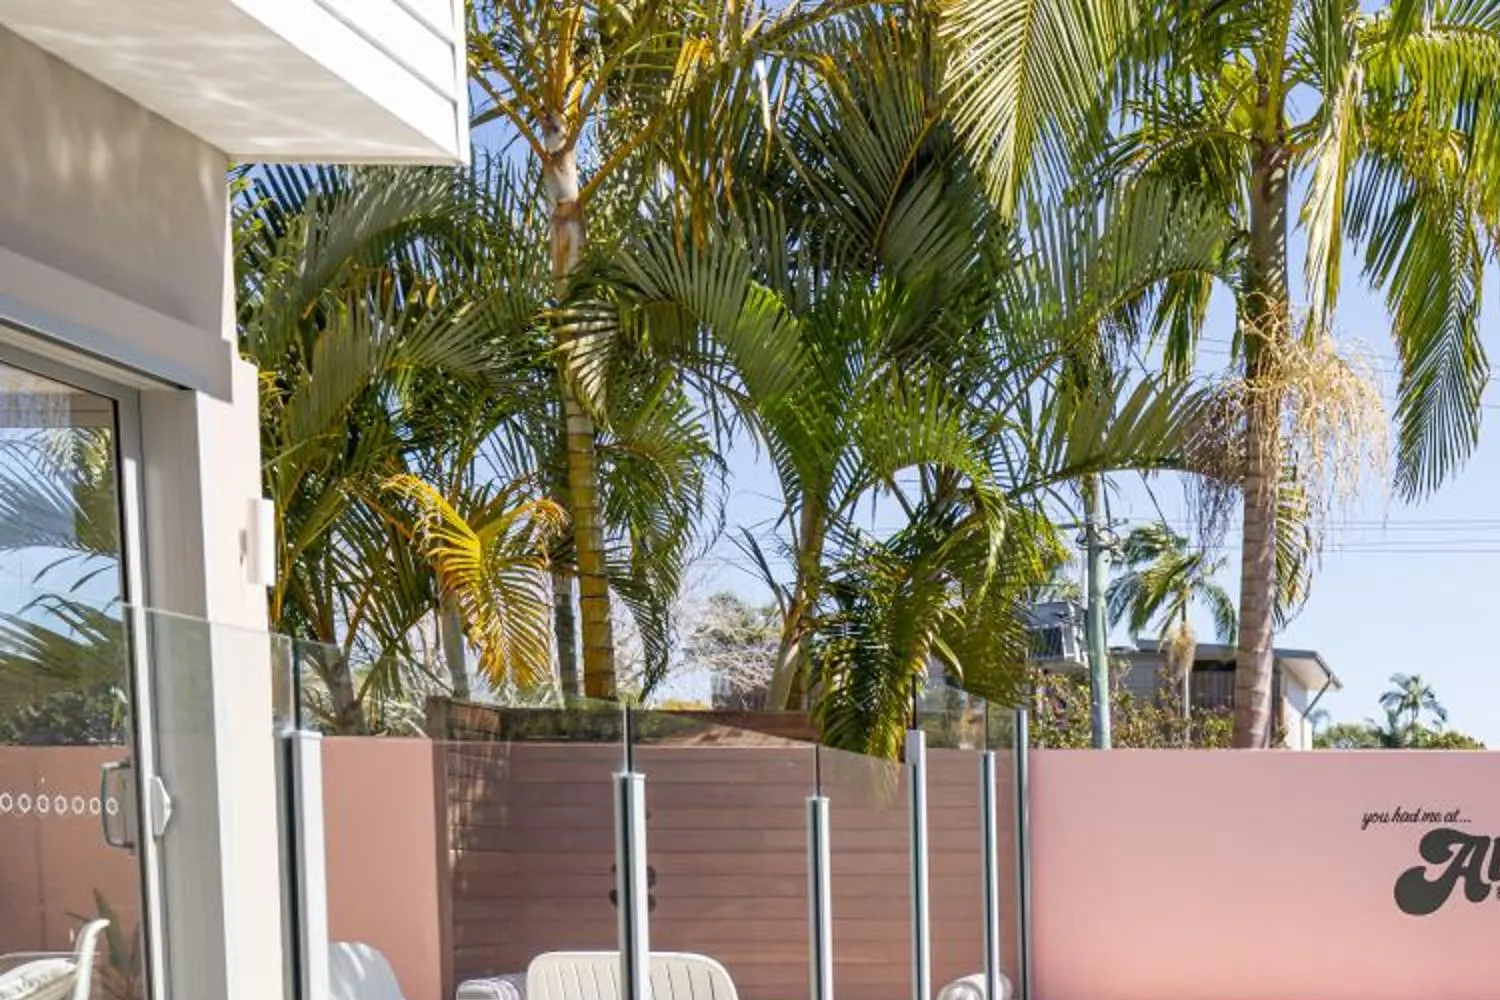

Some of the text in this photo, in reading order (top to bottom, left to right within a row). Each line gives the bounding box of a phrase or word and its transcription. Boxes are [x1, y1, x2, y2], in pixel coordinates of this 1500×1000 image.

[1361, 810, 1389, 829] you
[1391, 806, 1421, 823] had
[1422, 812, 1442, 823] me
